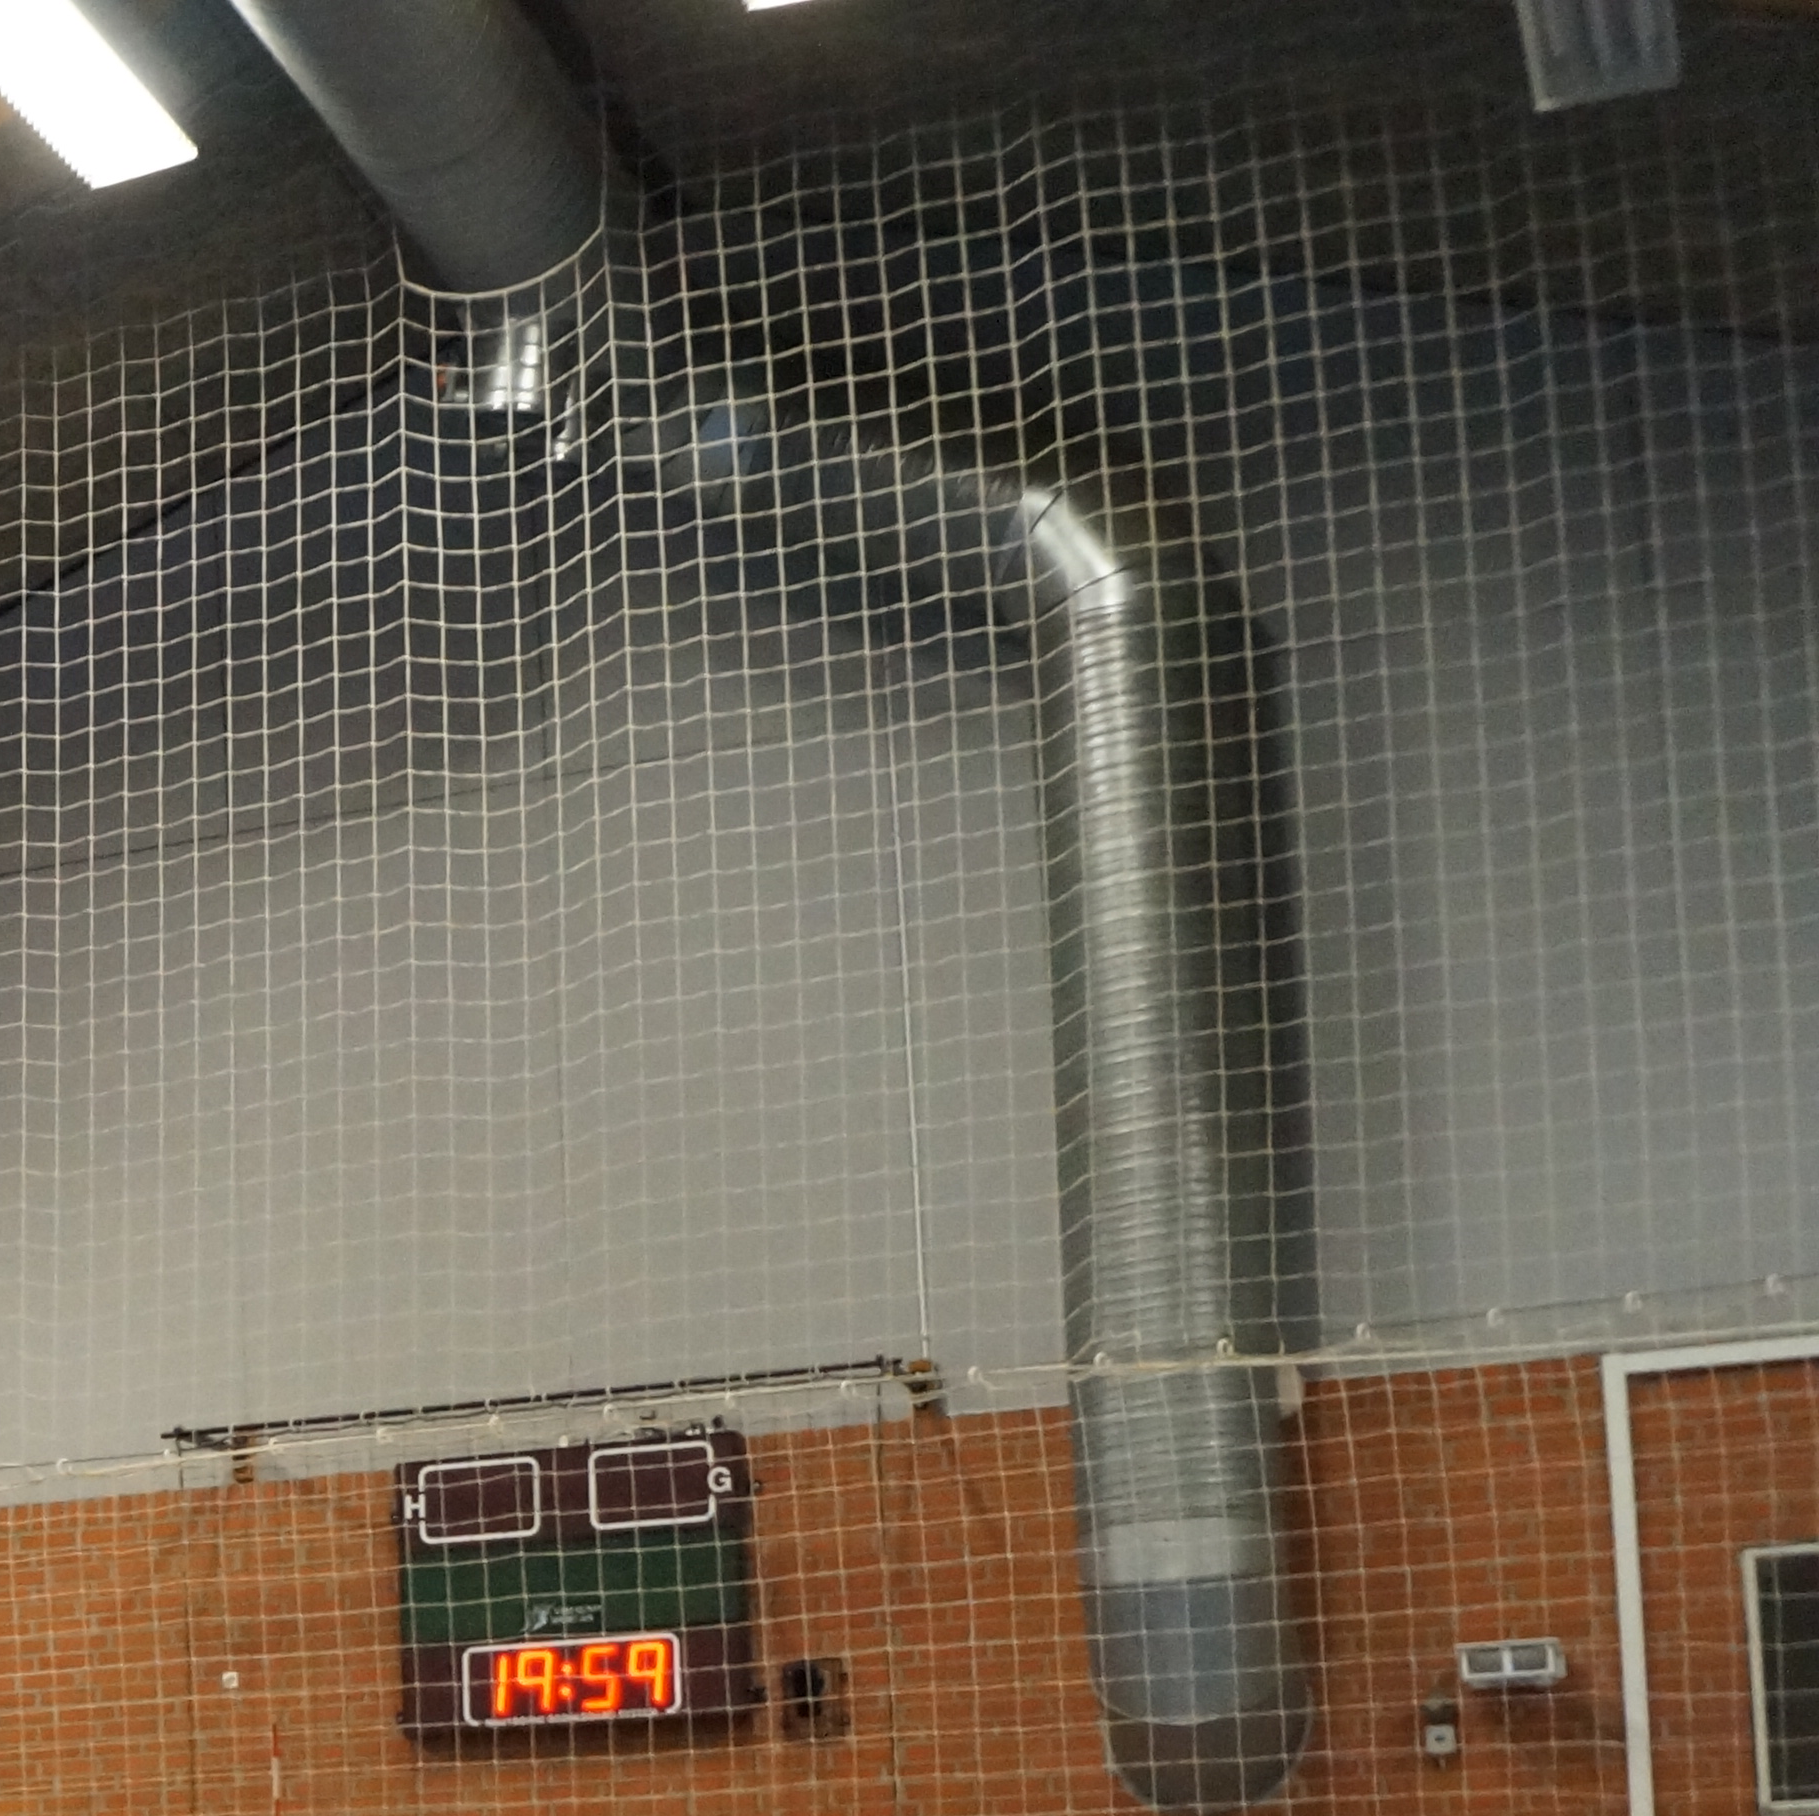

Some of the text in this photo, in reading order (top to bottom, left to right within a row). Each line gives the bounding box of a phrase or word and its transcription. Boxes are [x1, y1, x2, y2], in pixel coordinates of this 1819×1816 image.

[707, 1466, 733, 1493] G
[404, 1495, 425, 1519] H
[494, 1639, 669, 1716] 19:59
